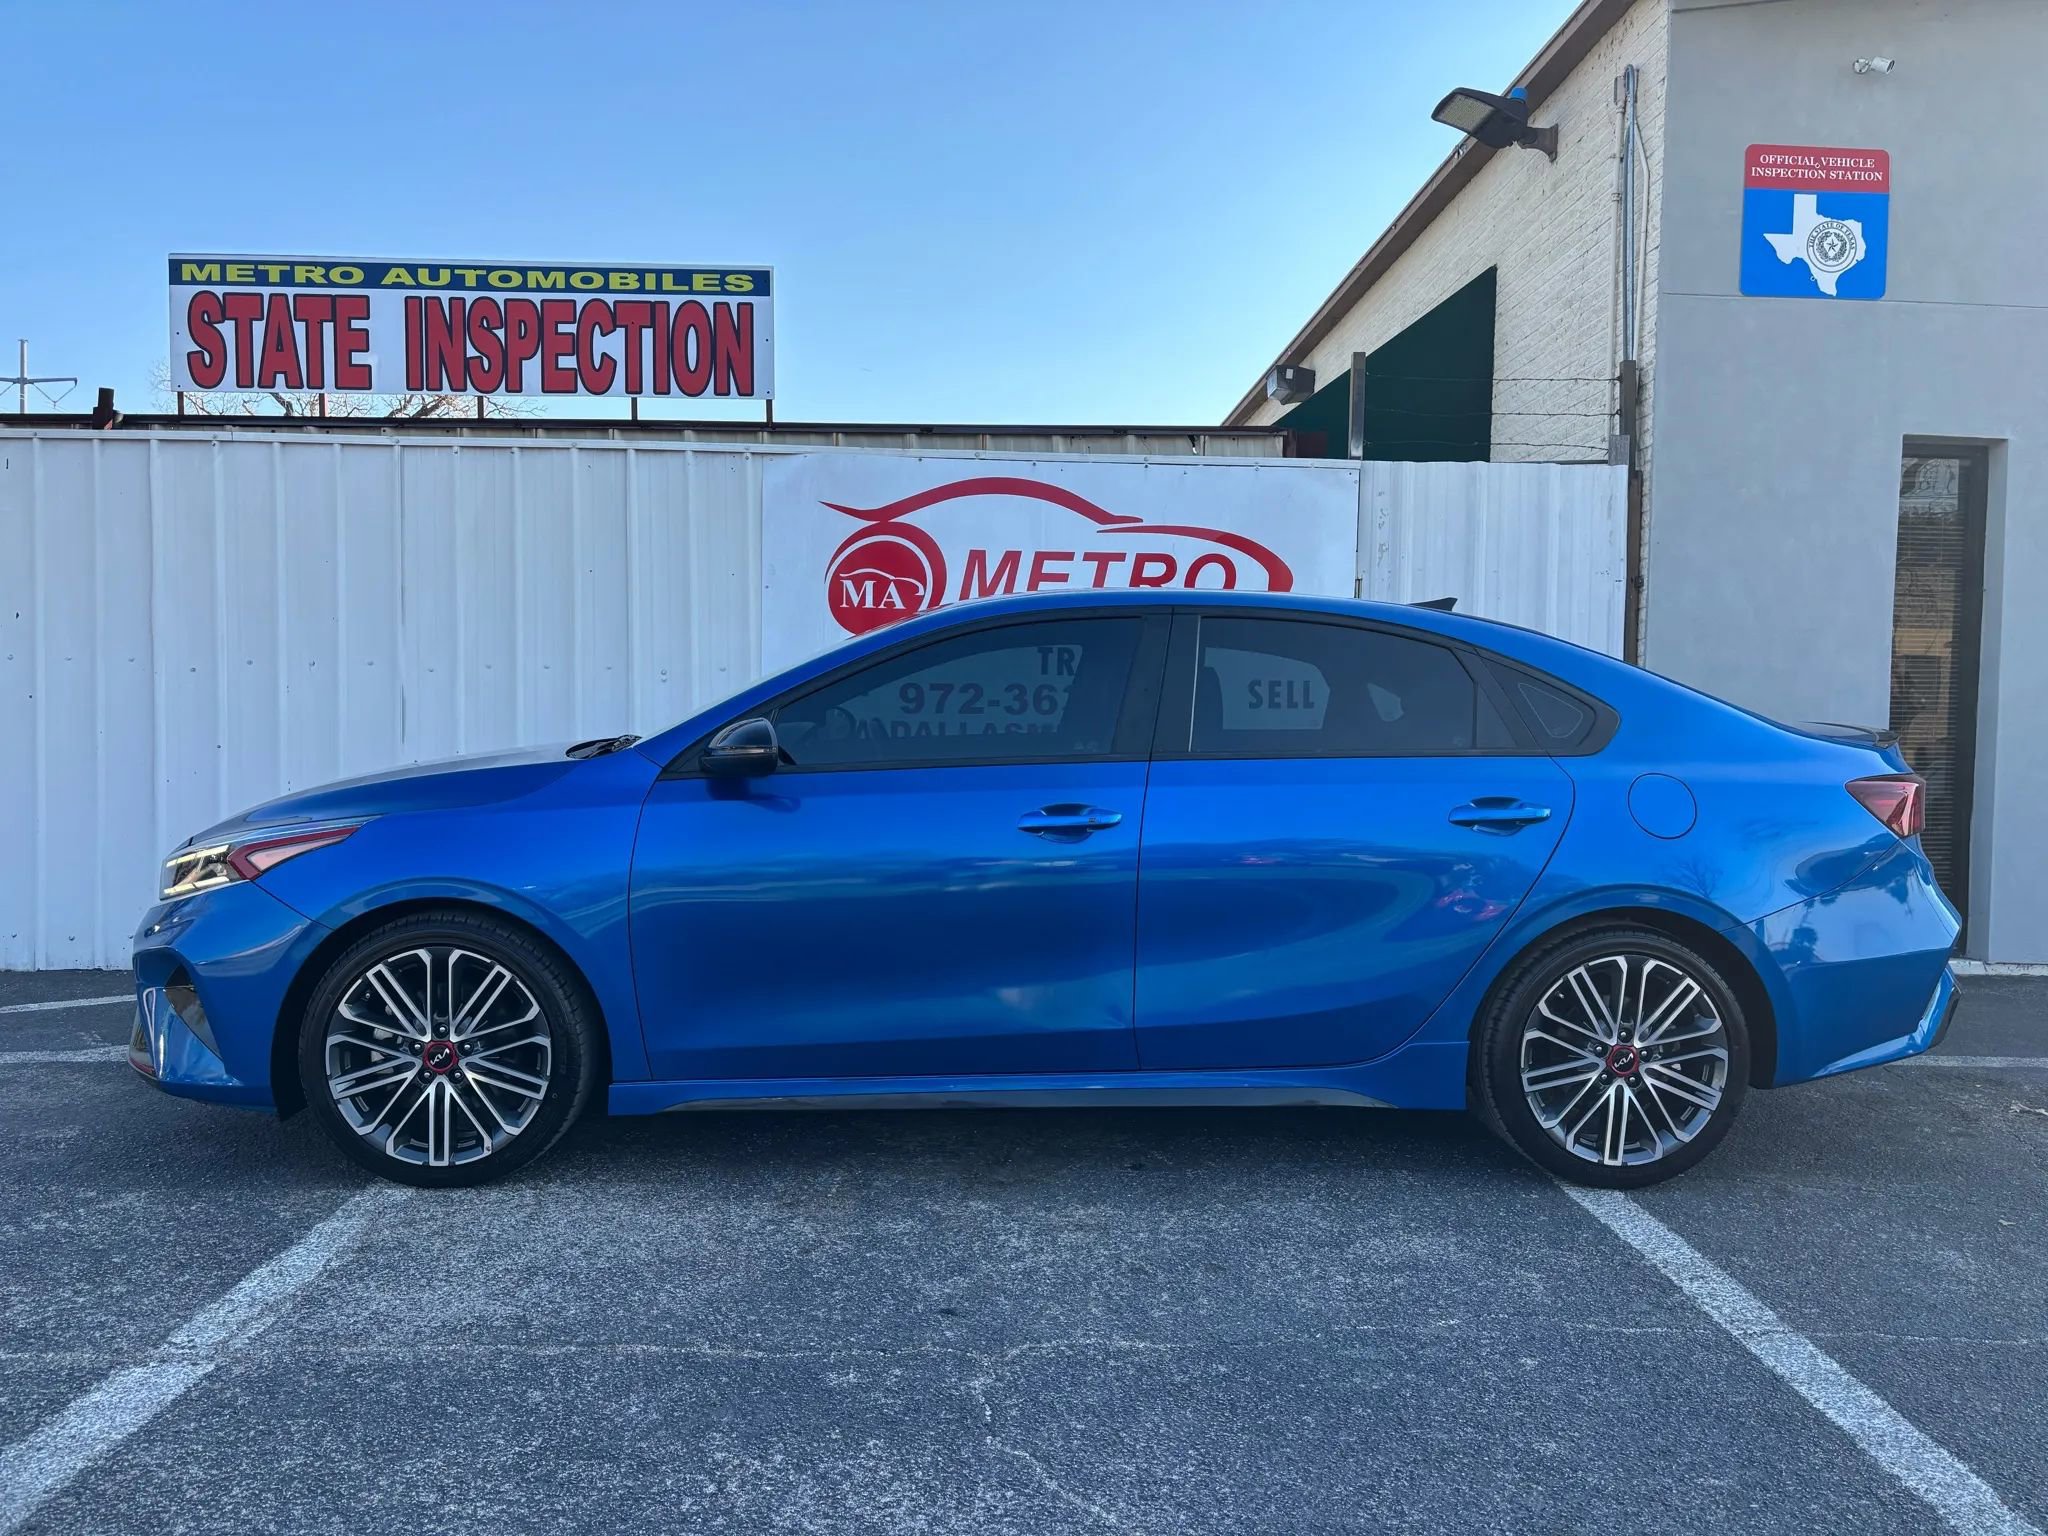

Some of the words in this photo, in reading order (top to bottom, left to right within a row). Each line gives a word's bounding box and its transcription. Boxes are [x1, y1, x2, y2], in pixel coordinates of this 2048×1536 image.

[1751, 167, 1826, 179] INSPECTION
[1829, 171, 1883, 181] STATION
[1760, 154, 1816, 166] OFFICIAL
[1821, 157, 1875, 168] VEHICLE
[180, 262, 365, 285] METRO
[380, 266, 755, 292] AUTOMOBILES
[187, 290, 372, 390] STATE
[403, 294, 754, 396] INSPECTION
[958, 549, 1237, 601] METRO
[839, 579, 907, 610] MA
[899, 682, 1073, 716] 972-36
[1247, 679, 1315, 710] SELL
